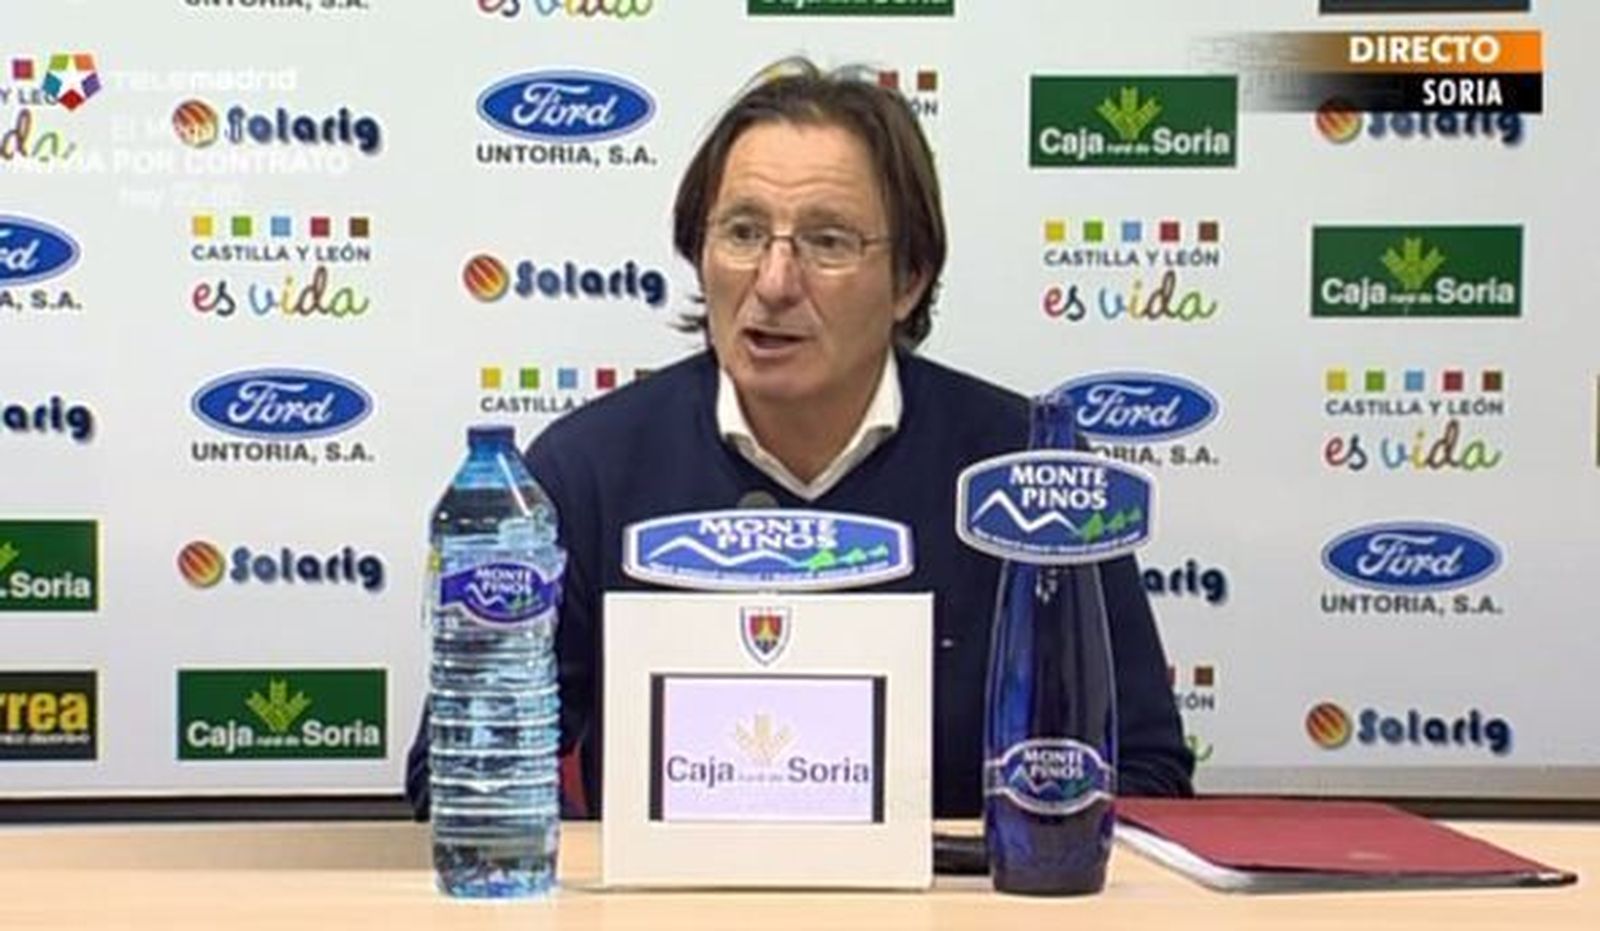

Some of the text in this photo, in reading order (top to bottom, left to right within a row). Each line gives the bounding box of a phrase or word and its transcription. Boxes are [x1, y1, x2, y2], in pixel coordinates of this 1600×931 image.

[512, 82, 618, 127] Ford
[226, 105, 382, 154] Solarig
[1039, 128, 1104, 160] Caja
[1152, 125, 1231, 155] Soria
[477, 146, 657, 166] UNTORIA, S.A.
[191, 242, 371, 261] CASTILLA Y LEÓN
[1044, 247, 1219, 267] CASTILLA Y LEÓN
[31, 290, 82, 309] S.A.
[193, 265, 370, 316] es vida
[515, 260, 667, 307] Solarig
[1043, 270, 1217, 321] es vida
[1321, 277, 1388, 311] Caja
[1434, 275, 1515, 304] Soria
[1, 394, 95, 443] arig
[227, 380, 335, 424] Ford
[480, 397, 577, 413] CASTILLA
[1077, 383, 1182, 427] Ford
[1325, 397, 1503, 415] CASTILLA Y LEÓN
[191, 443, 375, 464] UNTORIA, S.A.
[1170, 445, 1220, 465] S.A.
[1325, 419, 1502, 470] es vida
[1009, 465, 1109, 488] MONTE
[1021, 487, 1108, 511] PINOS
[700, 519, 839, 535] MONTE
[716, 532, 838, 549] PINOS
[230, 546, 385, 593] Solarig
[1357, 533, 1464, 577] Ford
[10, 571, 92, 598] Soria
[1141, 560, 1227, 605] arig
[1321, 595, 1503, 617] UNTORIA, S.A.
[0, 692, 88, 732] rea
[186, 720, 253, 753] Caja
[301, 719, 380, 747] Soria
[1358, 708, 1513, 755] Solarig
[666, 756, 871, 787] Caja Soria
